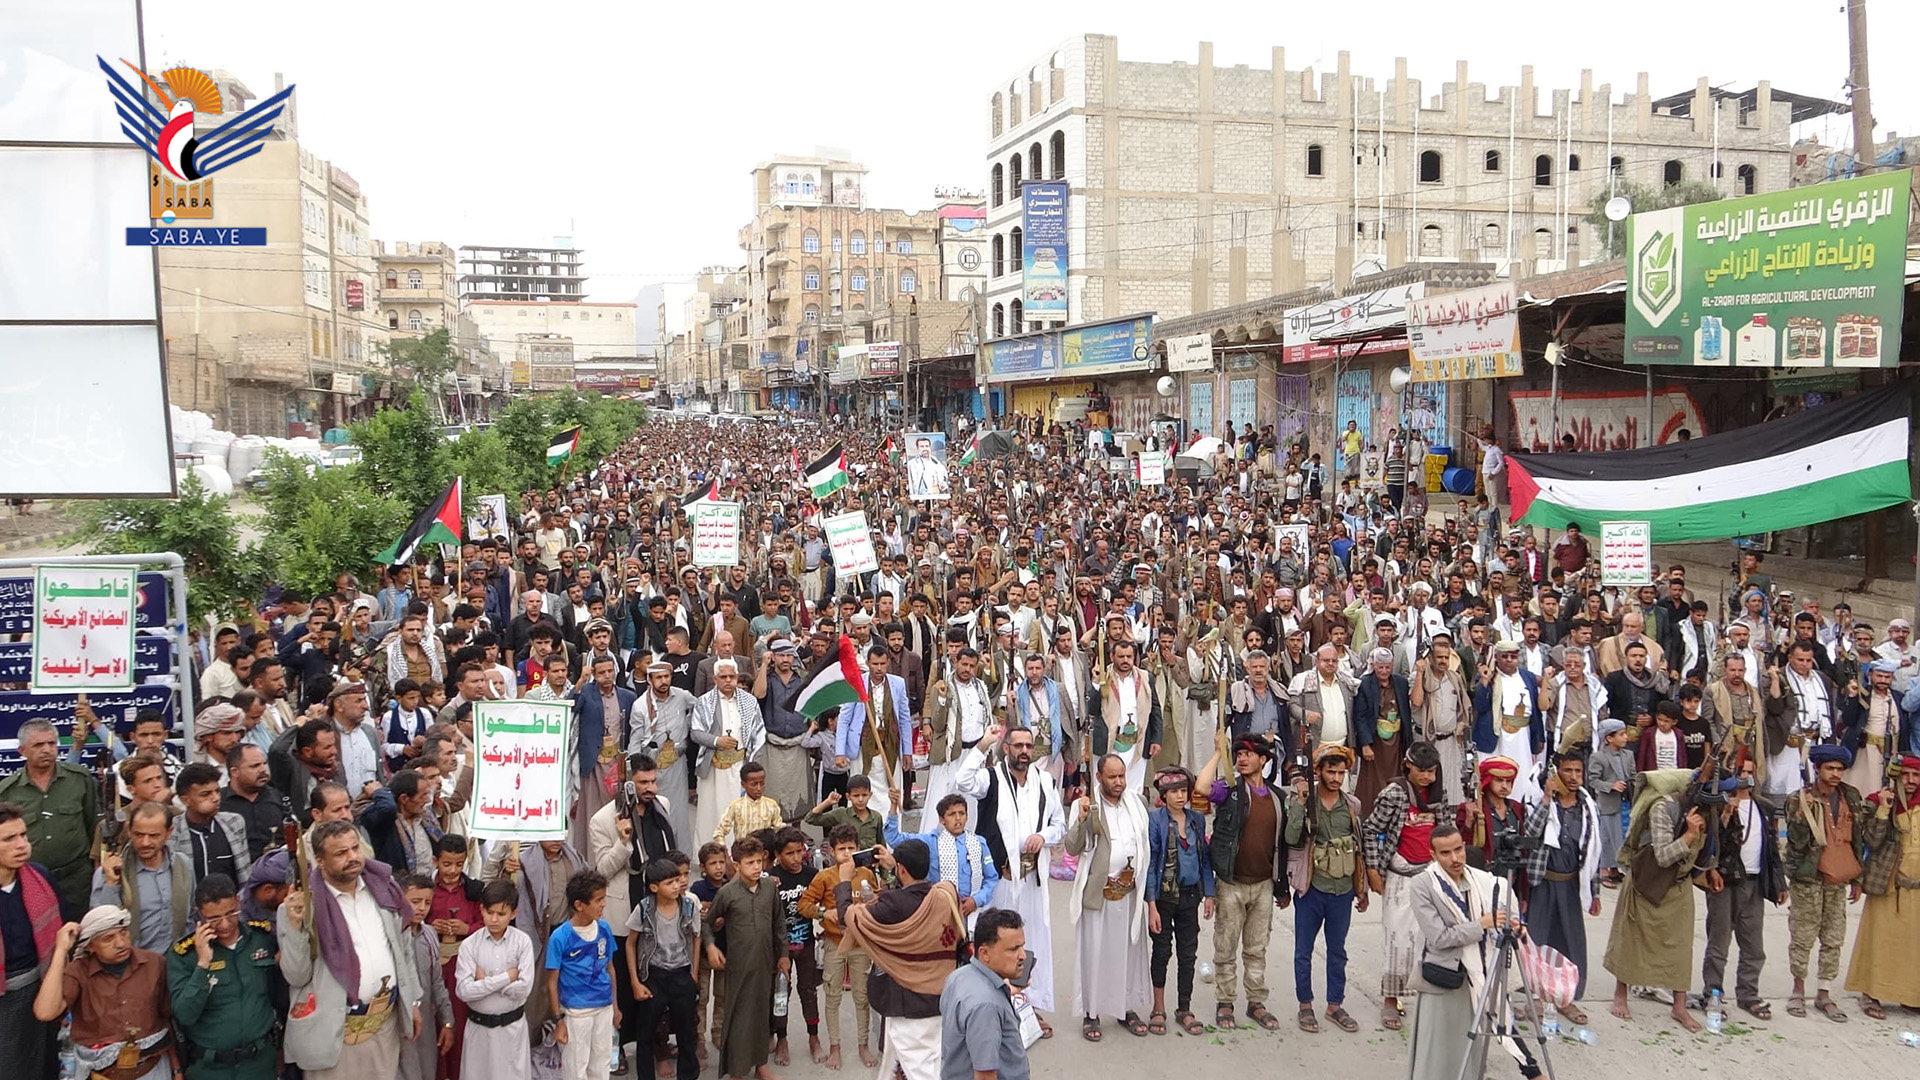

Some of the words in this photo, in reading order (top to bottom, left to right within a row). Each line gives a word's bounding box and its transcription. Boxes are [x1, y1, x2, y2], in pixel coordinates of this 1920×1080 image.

[1756, 198, 1823, 237] للتنمية
[1827, 187, 1894, 229] الزقري
[1697, 206, 1754, 244] الزراعية
[1762, 241, 1811, 278] الإنتاج
[1814, 235, 1876, 271] وزيادة
[1704, 246, 1759, 289] الزراعي
[1701, 294, 1735, 308] AL-ZAQRI
[1735, 294, 1751, 306] FOR
[1750, 289, 1810, 305] AGRICULTURAL
[1810, 285, 1877, 301] DEVELOPMENT
[1424, 297, 1470, 335] للأحذية
[1474, 290, 1510, 331] العزي
[43, 576, 129, 602] قاطعوا
[42, 606, 88, 629] الأمريكية
[88, 609, 128, 630] البضائع
[80, 634, 87, 650] و
[41, 657, 127, 678] الإسرائيلية
[0, 703, 37, 713] عبدالوها
[135, 694, 164, 706] مشروع
[481, 711, 561, 738] قاطعوا
[482, 743, 521, 766] الأمريكية
[523, 746, 560, 768] البضائع
[515, 773, 521, 790] و
[479, 796, 558, 821] الإسرائيلية
